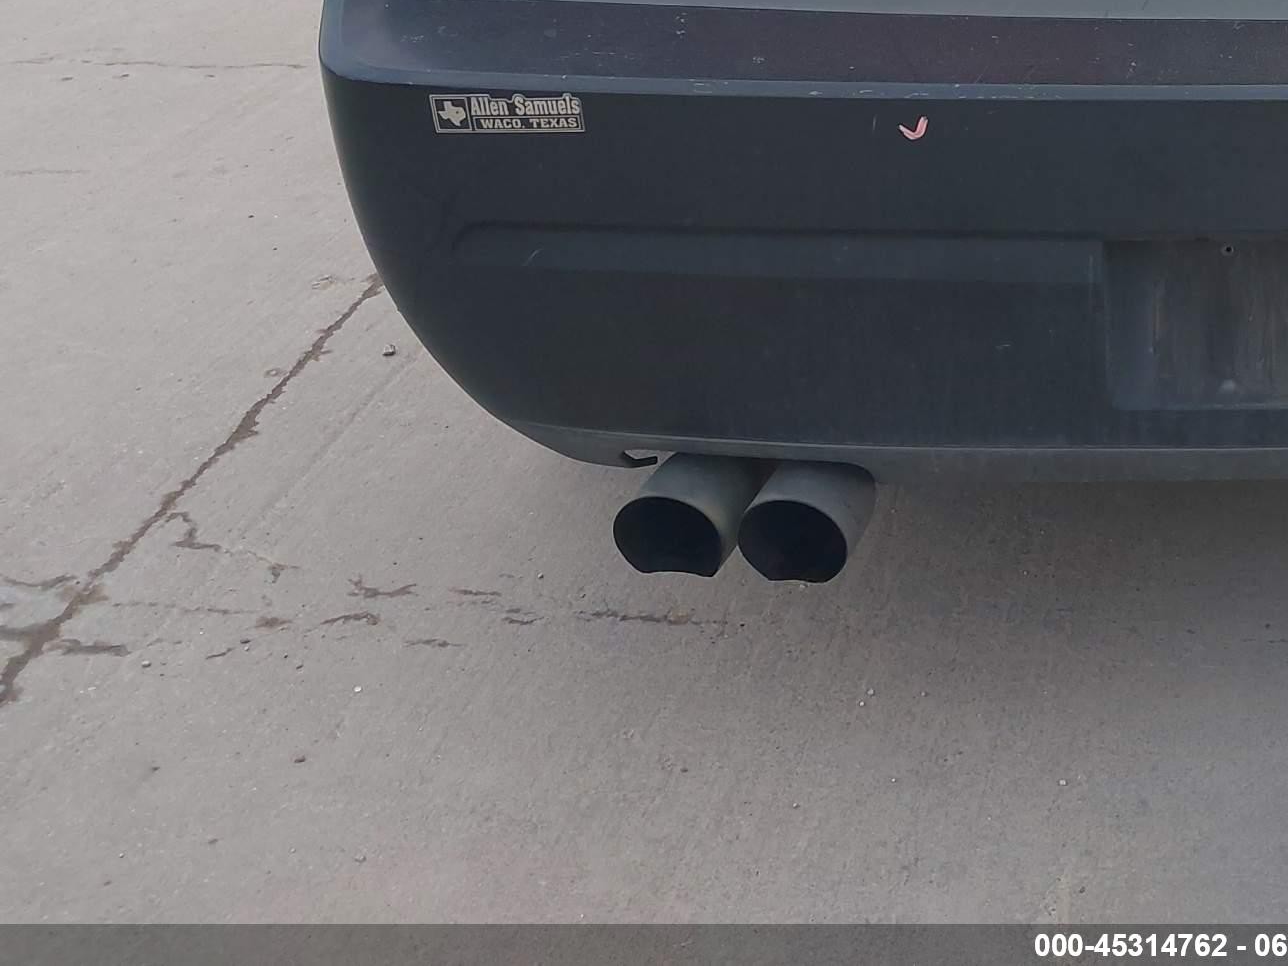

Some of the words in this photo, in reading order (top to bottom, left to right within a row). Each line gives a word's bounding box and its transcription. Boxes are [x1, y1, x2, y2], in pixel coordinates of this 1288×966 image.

[471, 96, 510, 116] Allen
[513, 95, 581, 115] Samuels
[529, 117, 578, 129] TEXAS
